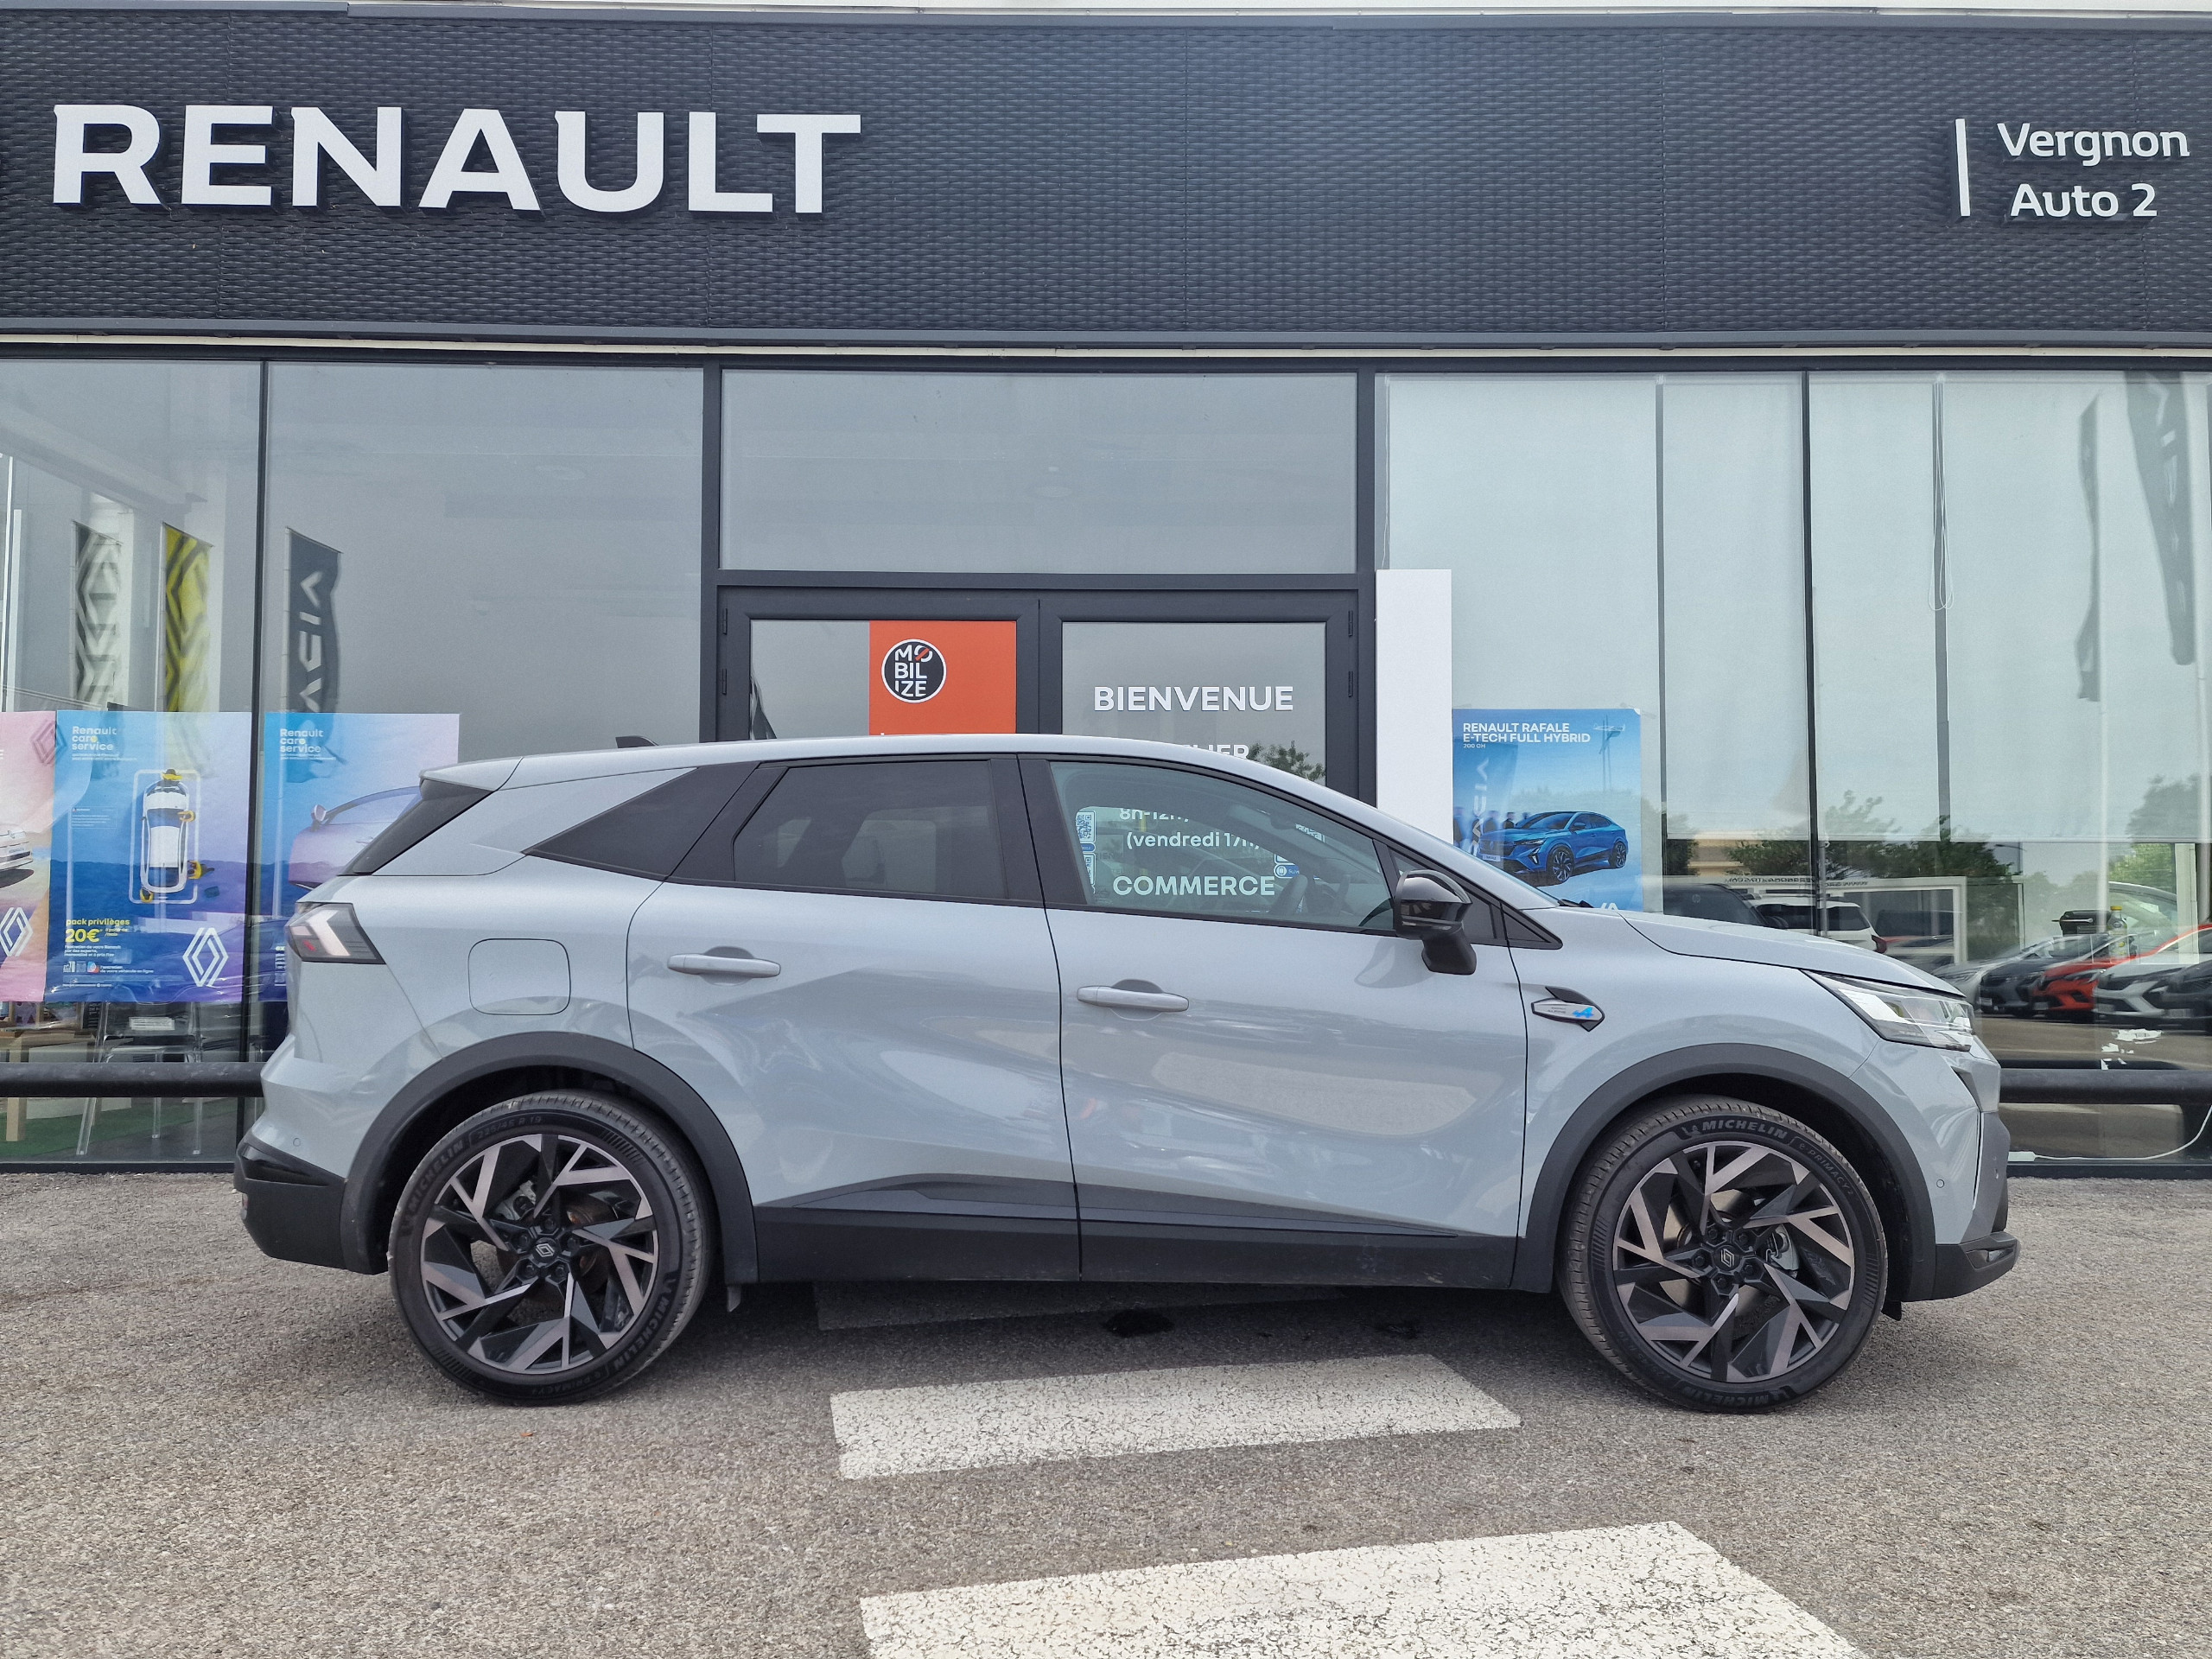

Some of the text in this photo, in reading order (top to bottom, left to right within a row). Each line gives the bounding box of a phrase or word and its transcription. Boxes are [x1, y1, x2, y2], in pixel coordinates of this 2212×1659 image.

[1997, 123, 2190, 166] Vergnon
[54, 104, 861, 214] RENAULT
[2010, 183, 2158, 217] Auto 2
[894, 663, 927, 679] BIL
[894, 680, 927, 697] IZE
[1094, 686, 1294, 711] BIENVENUE
[72, 726, 118, 734] Renault
[280, 728, 324, 737] Renault
[1463, 723, 1570, 733] RENAULT RAFALE
[72, 742, 114, 751] service
[1463, 733, 1591, 743] E-TECH FULL HYBRID
[280, 744, 321, 753] service
[1127, 832, 1219, 850] (vendredi
[1113, 875, 1275, 896] COMMERCE
[88, 918, 130, 926] privilèges
[1702, 1120, 1788, 1139] MICHELIN
[408, 1140, 464, 1210] MICHELIN
[613, 1297, 670, 1370] MICHELIN
